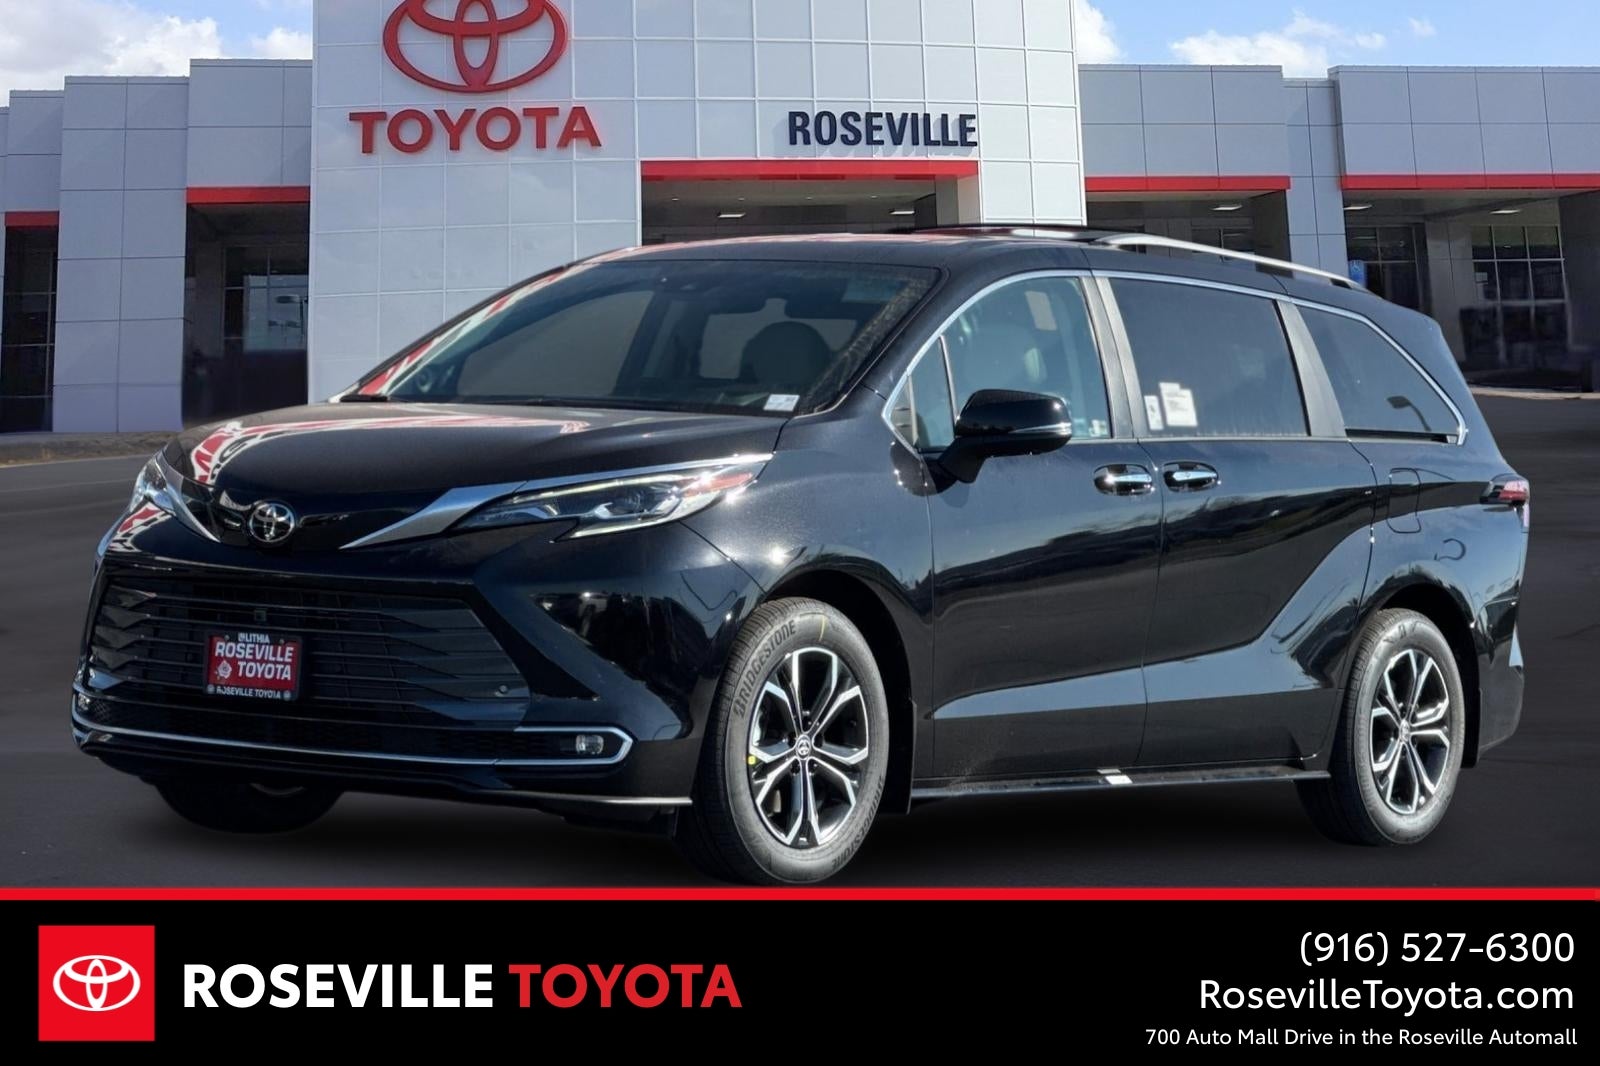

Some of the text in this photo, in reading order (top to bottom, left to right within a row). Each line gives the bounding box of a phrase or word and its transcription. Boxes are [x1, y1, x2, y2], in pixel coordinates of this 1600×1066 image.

[349, 106, 602, 154] TOYOTA
[788, 110, 978, 147] ROSEVILLE
[215, 641, 294, 662] ROSEVILLE
[245, 633, 270, 644] LITHIA
[237, 661, 292, 681] TOYOTA
[733, 619, 797, 719] BRIDGESTONE
